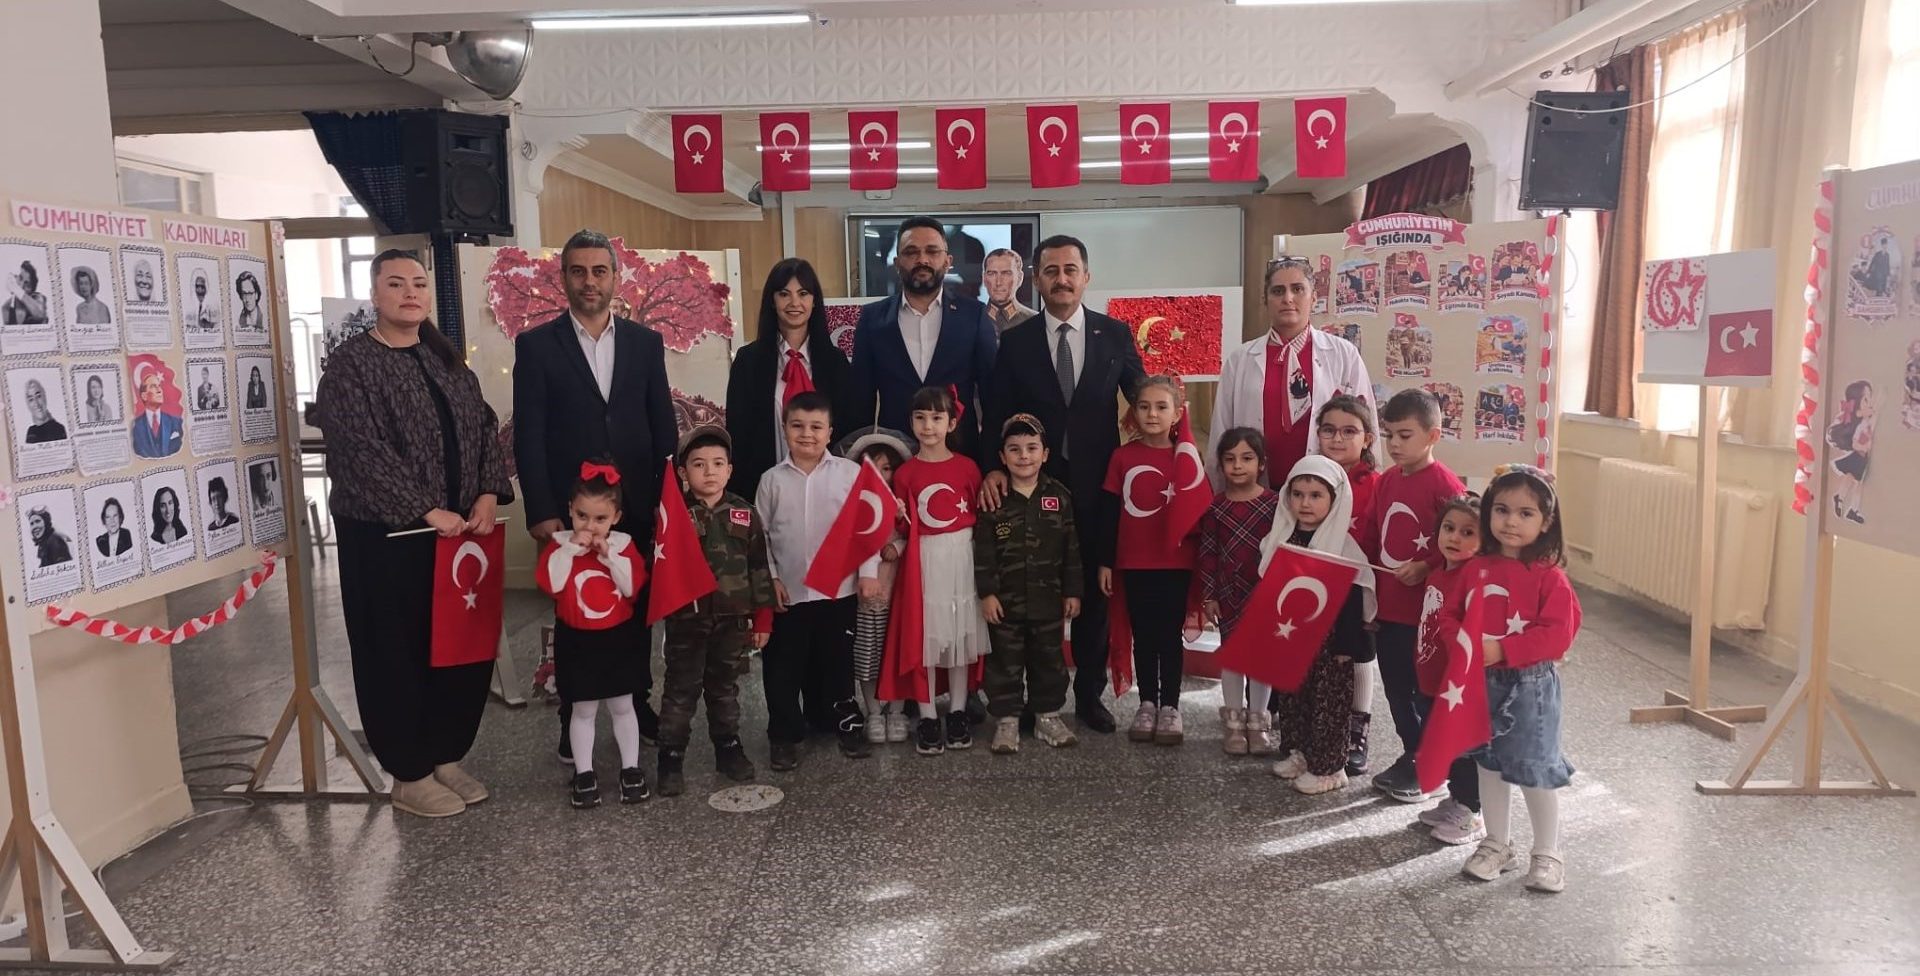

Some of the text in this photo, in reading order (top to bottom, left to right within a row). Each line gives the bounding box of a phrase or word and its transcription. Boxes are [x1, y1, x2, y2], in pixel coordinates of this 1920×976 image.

[19, 206, 246, 249] CUMHURİYET KADINLARI
[1358, 215, 1453, 235] CUMHURİYETİN
[1376, 231, 1432, 246] IŞIĞINDA
